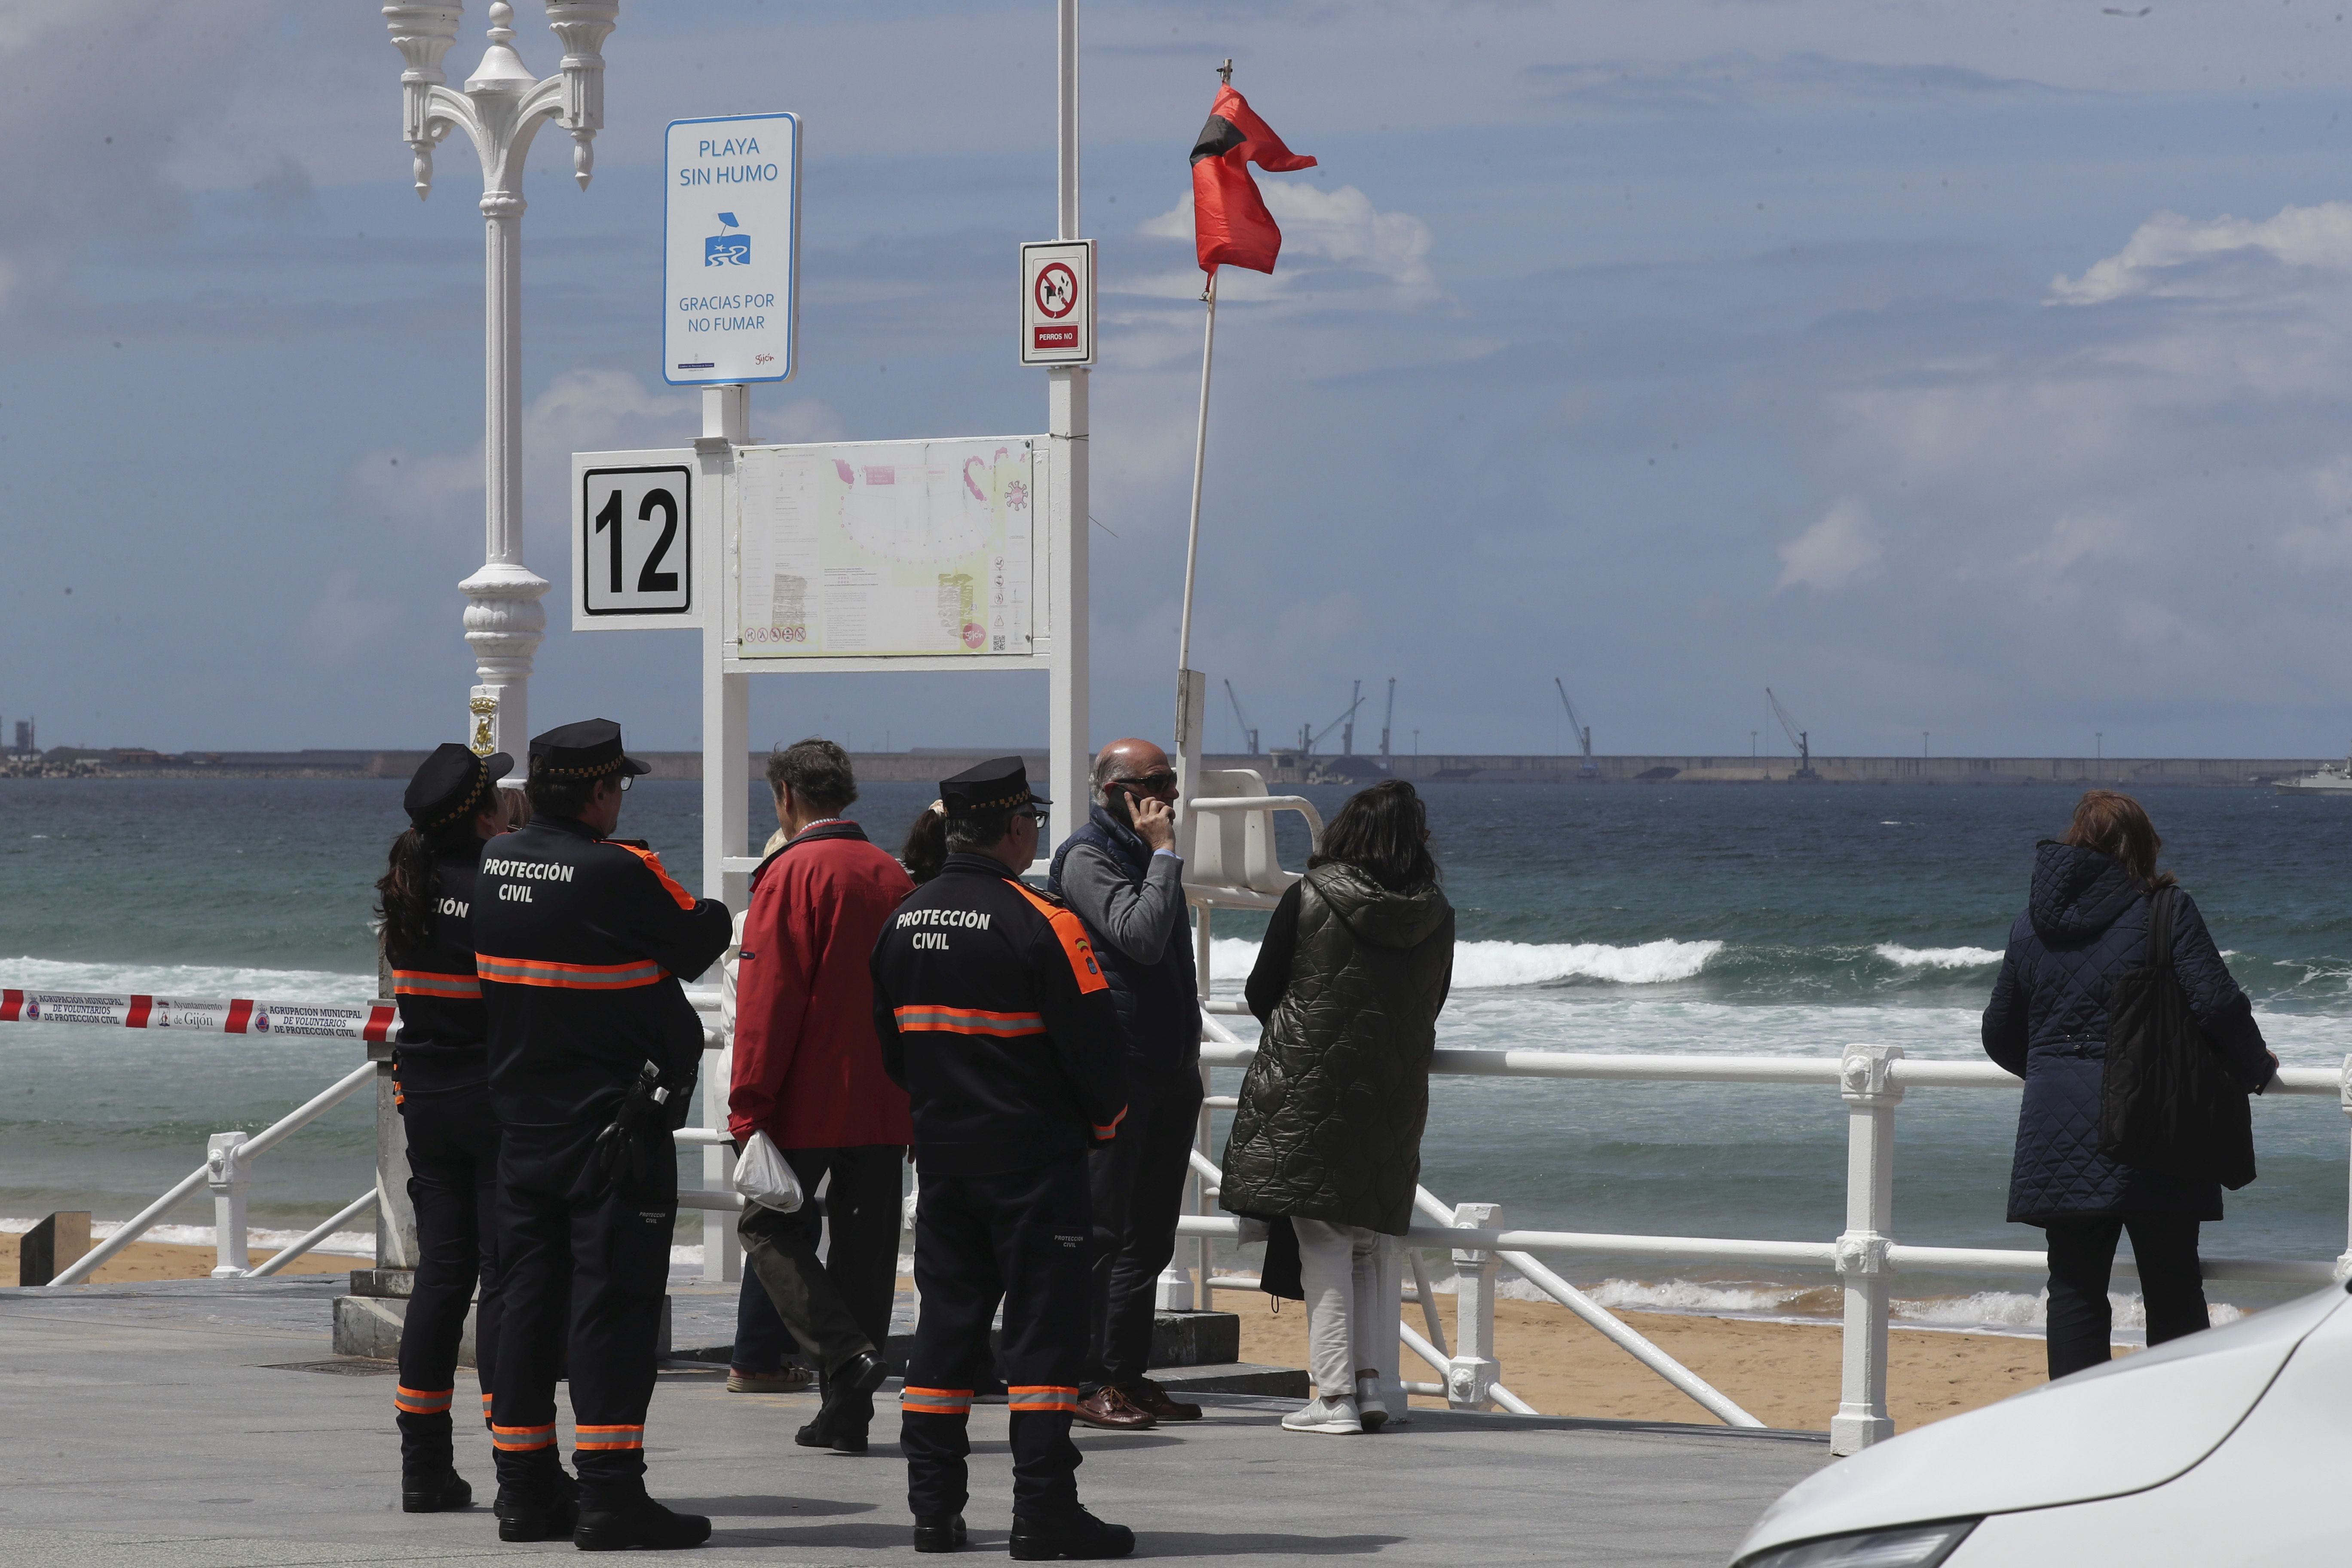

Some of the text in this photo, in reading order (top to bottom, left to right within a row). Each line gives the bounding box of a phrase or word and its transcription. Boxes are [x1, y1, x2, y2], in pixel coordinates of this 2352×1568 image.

[699, 138, 760, 157] PLAYA
[680, 163, 778, 186] SIN HUMO
[680, 294, 774, 311] GRACIAS POR
[689, 316, 765, 332] NO FUMAR
[756, 353, 774, 365] gijón
[596, 488, 678, 593] 12
[483, 858, 574, 882] PROTECCIÓN
[499, 884, 533, 903] CIVIL
[896, 910, 991, 930] PROTECCIÓN
[912, 933, 949, 950] CIVIL
[40, 995, 123, 1005] AGRUPACIÓN MUNICIPAL
[174, 1001, 222, 1011] Ayuntamiento
[64, 1005, 110, 1014] VOLUNTARIOS
[270, 1006, 362, 1018] AGRUPACIÓN MUNICIPAL
[55, 1014, 101, 1023] PROTECCIÓN
[101, 1016, 119, 1024] CIVIL
[174, 1012, 213, 1029] de Gijón
[283, 1017, 346, 1027] DE VOLUNTARIOS
[274, 1026, 356, 1037] DE PROTECCIÓN CIVIL
